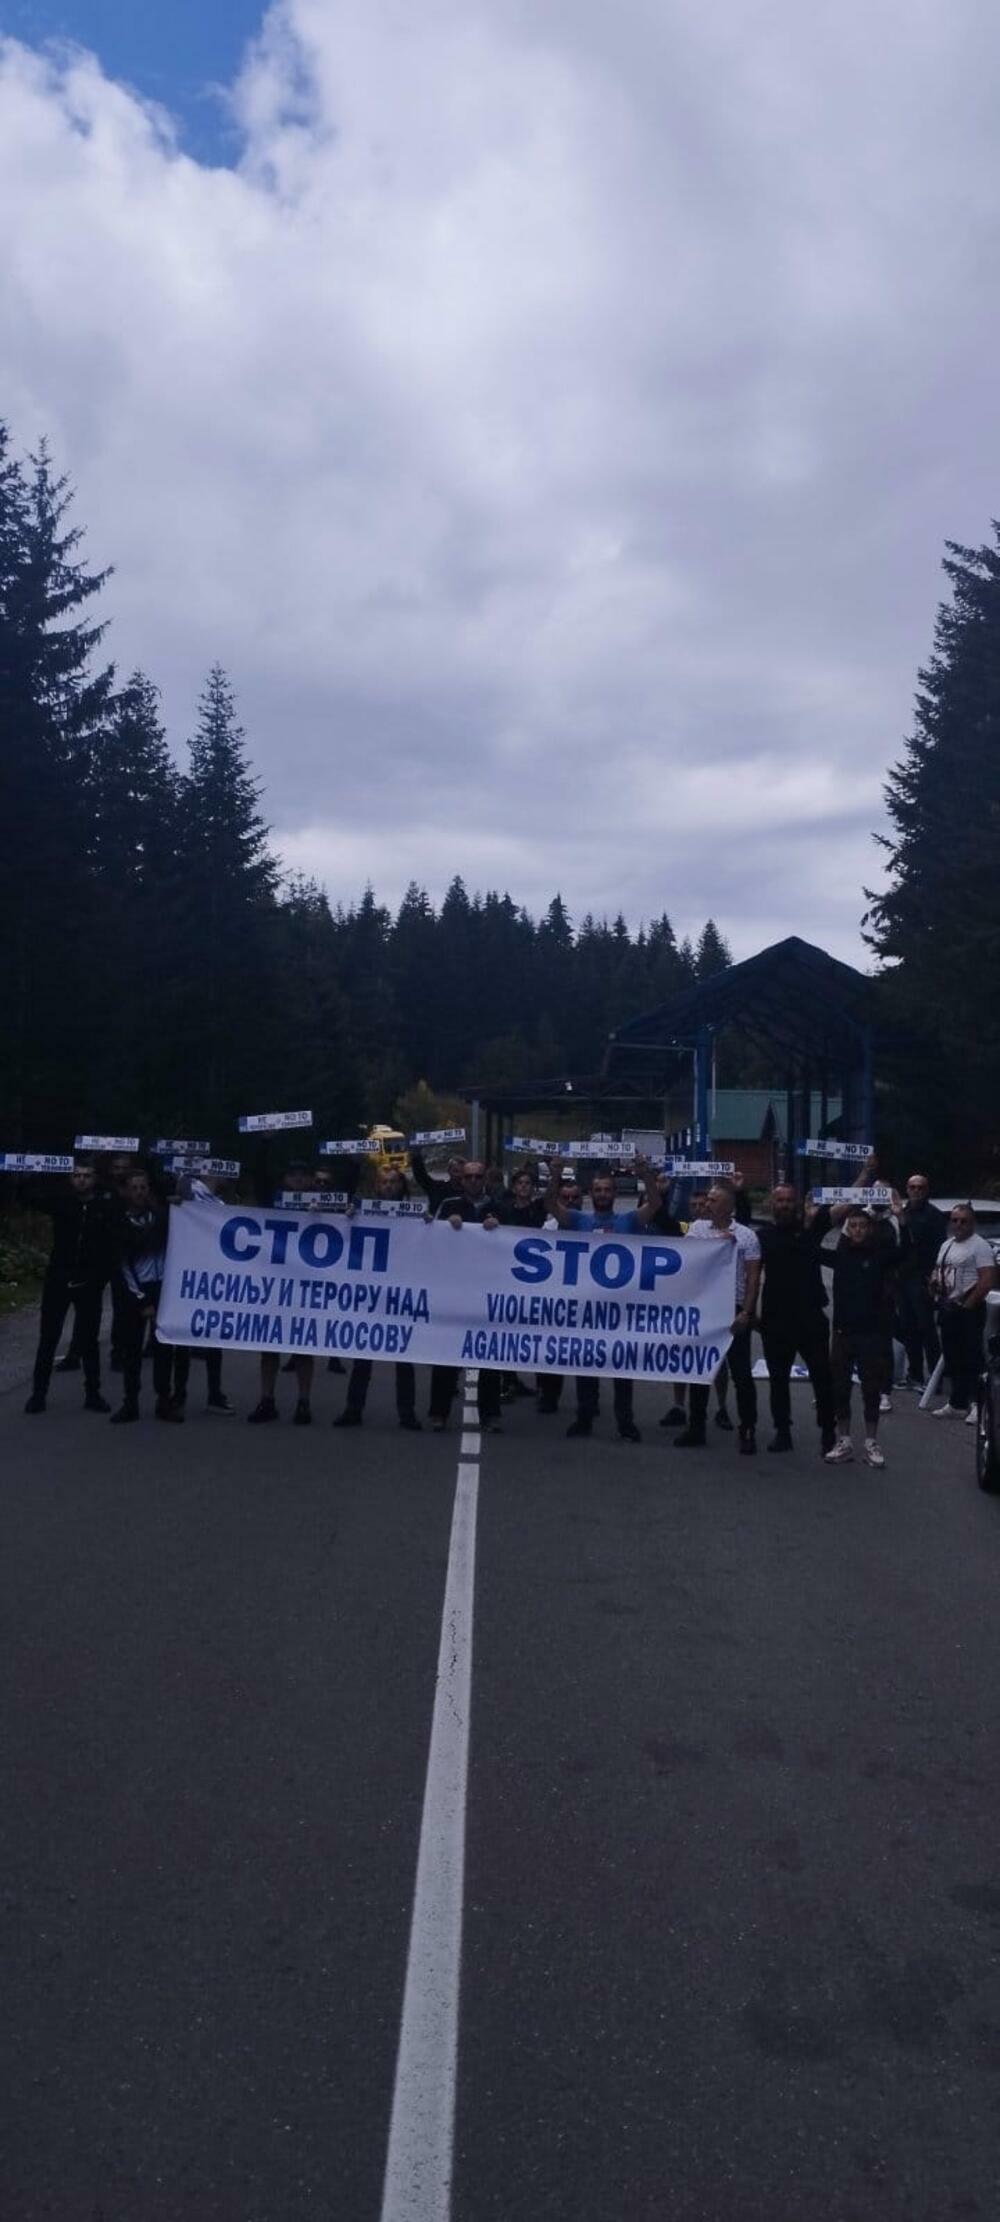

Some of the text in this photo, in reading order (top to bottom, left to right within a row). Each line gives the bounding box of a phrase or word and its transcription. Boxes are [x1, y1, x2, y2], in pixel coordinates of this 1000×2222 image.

[219, 1216, 390, 1272] СТОП
[511, 1238, 682, 1291] STOP
[180, 1270, 430, 1323] НАСИЉУ И ТЕРОРУ НАД
[487, 1293, 701, 1336] VIOLENCE AND TERROR
[190, 1308, 413, 1353] СРБИМА НА КОСОВУ
[461, 1330, 542, 1363] AGAINST
[545, 1336, 606, 1369] SERBS
[612, 1340, 638, 1370] ON
